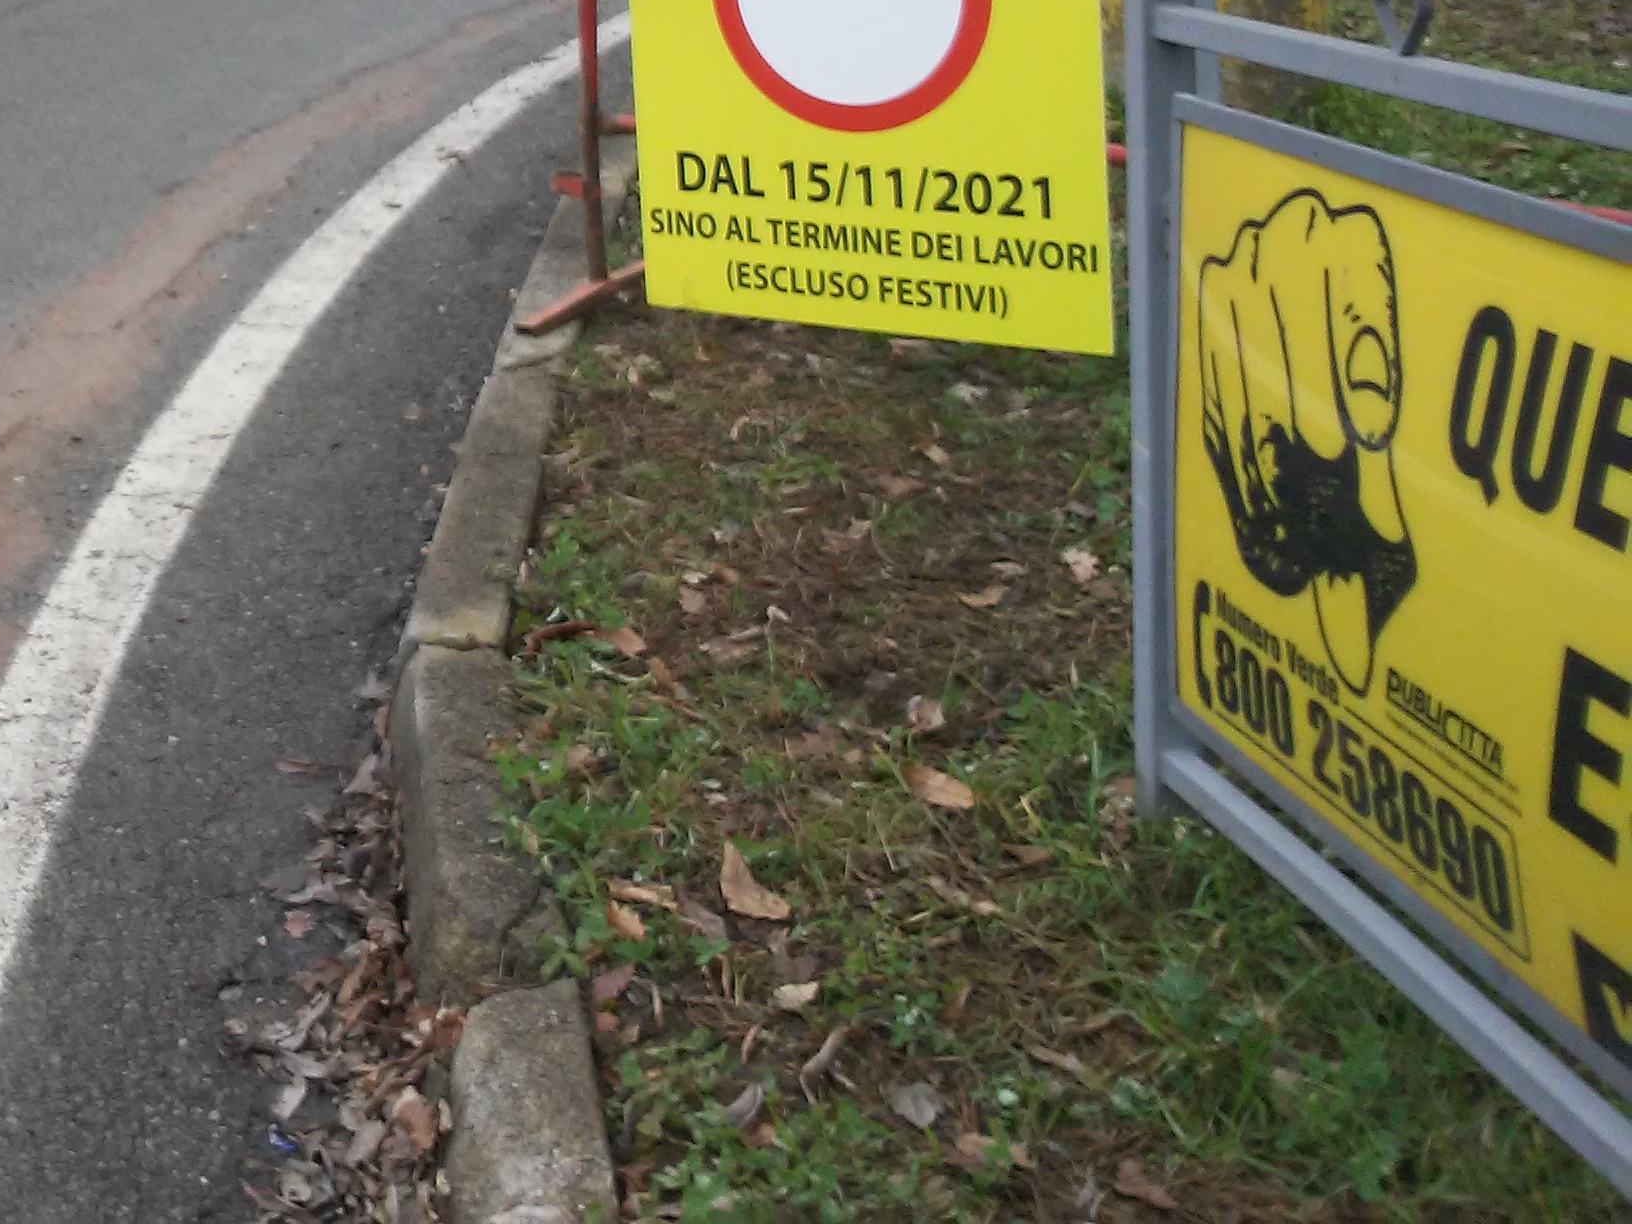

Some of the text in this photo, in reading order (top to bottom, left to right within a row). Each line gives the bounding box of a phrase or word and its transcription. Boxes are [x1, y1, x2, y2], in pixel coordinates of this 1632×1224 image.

[675, 151, 1054, 220] DAL 15/11/2021
[650, 208, 1099, 274] SINO AL TERMINE DEI LAVORI
[726, 261, 1008, 319] (ESCLUSO FESTIVI)
[1285, 638, 1340, 708] Verde
[1214, 630, 1295, 759] 800
[1306, 698, 1515, 934] 258690
